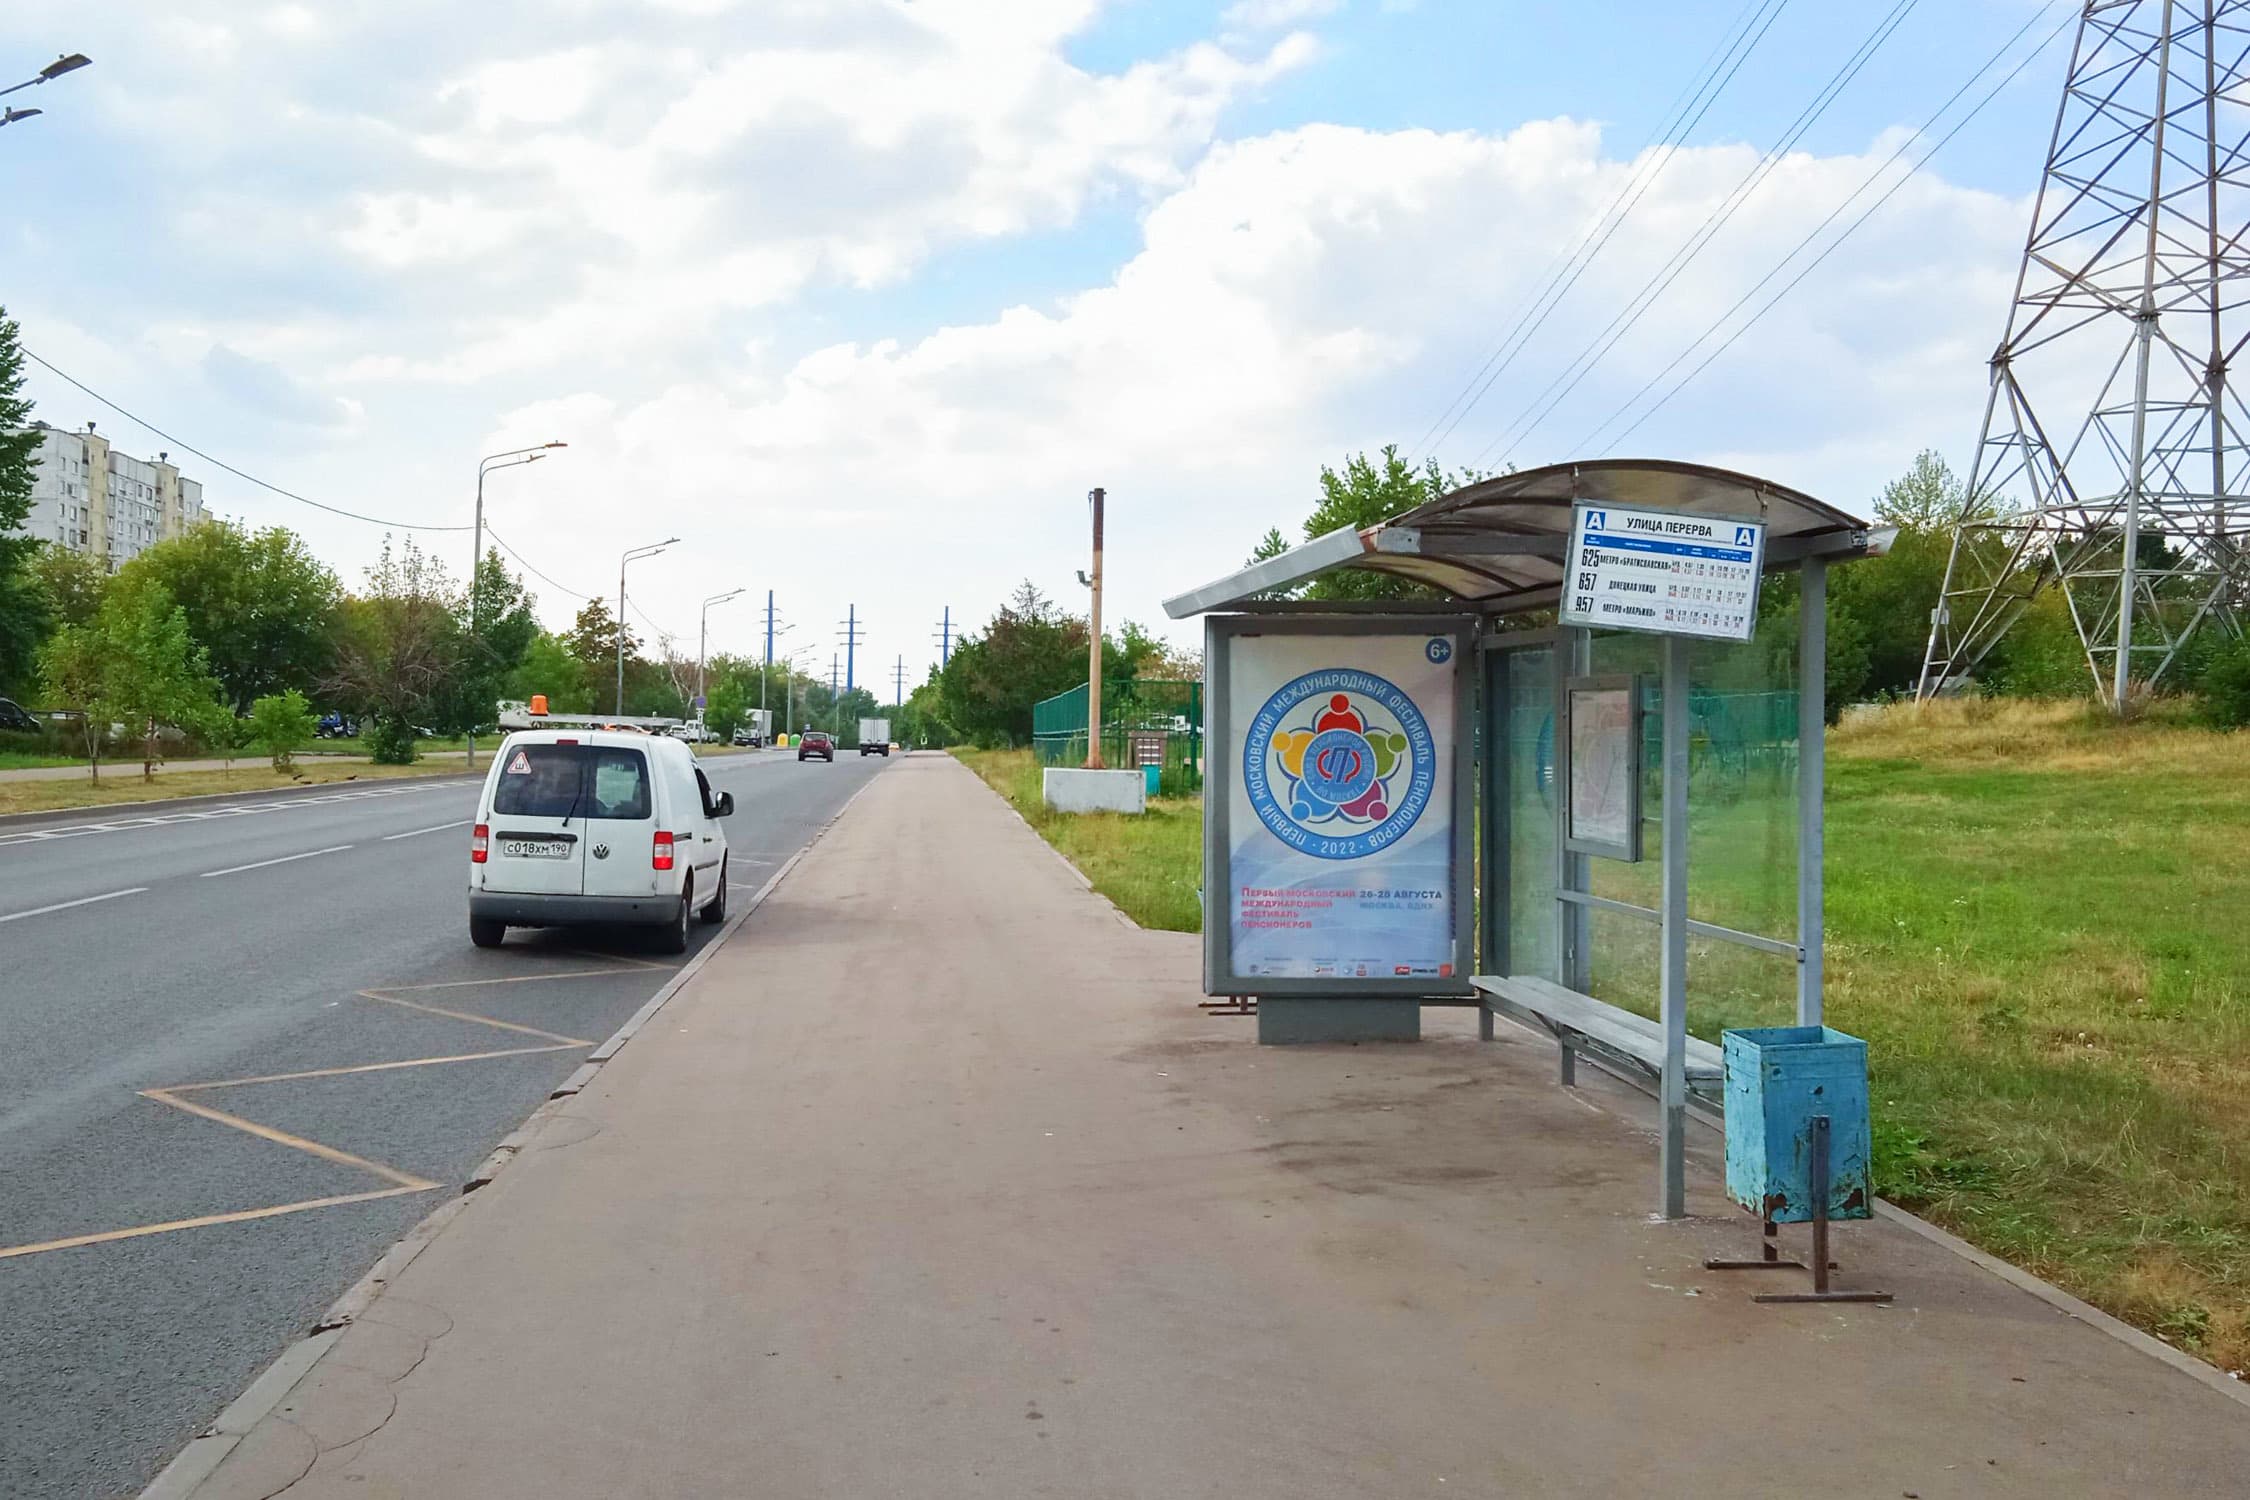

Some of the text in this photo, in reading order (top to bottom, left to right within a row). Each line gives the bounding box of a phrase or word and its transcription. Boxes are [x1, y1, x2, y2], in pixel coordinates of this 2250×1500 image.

[1627, 517, 1712, 537] УЛИЦА ПЕРЕРВА
[1582, 548, 1600, 567] 625
[1600, 554, 1619, 566] МЕТРО
[1578, 572, 1597, 591] 657
[1575, 596, 1594, 613] 957
[1602, 603, 1622, 614] МЕТРО
[1430, 644, 1449, 658] 6+
[1273, 674, 1387, 712] МЕЖДУНАРОДНЫЙ
[1389, 695, 1430, 765] ФЕСТИВАЛЬ
[514, 762, 524, 770] Ш
[1249, 713, 1275, 800] МОСКОВСКИЙ
[1368, 770, 1430, 847] ПЕНСИОНЕРОВ
[1260, 803, 1306, 845] ПЕРВЫЙ
[1320, 841, 1356, 854] 2022
[1393, 890, 1442, 899] АВГУСТА
